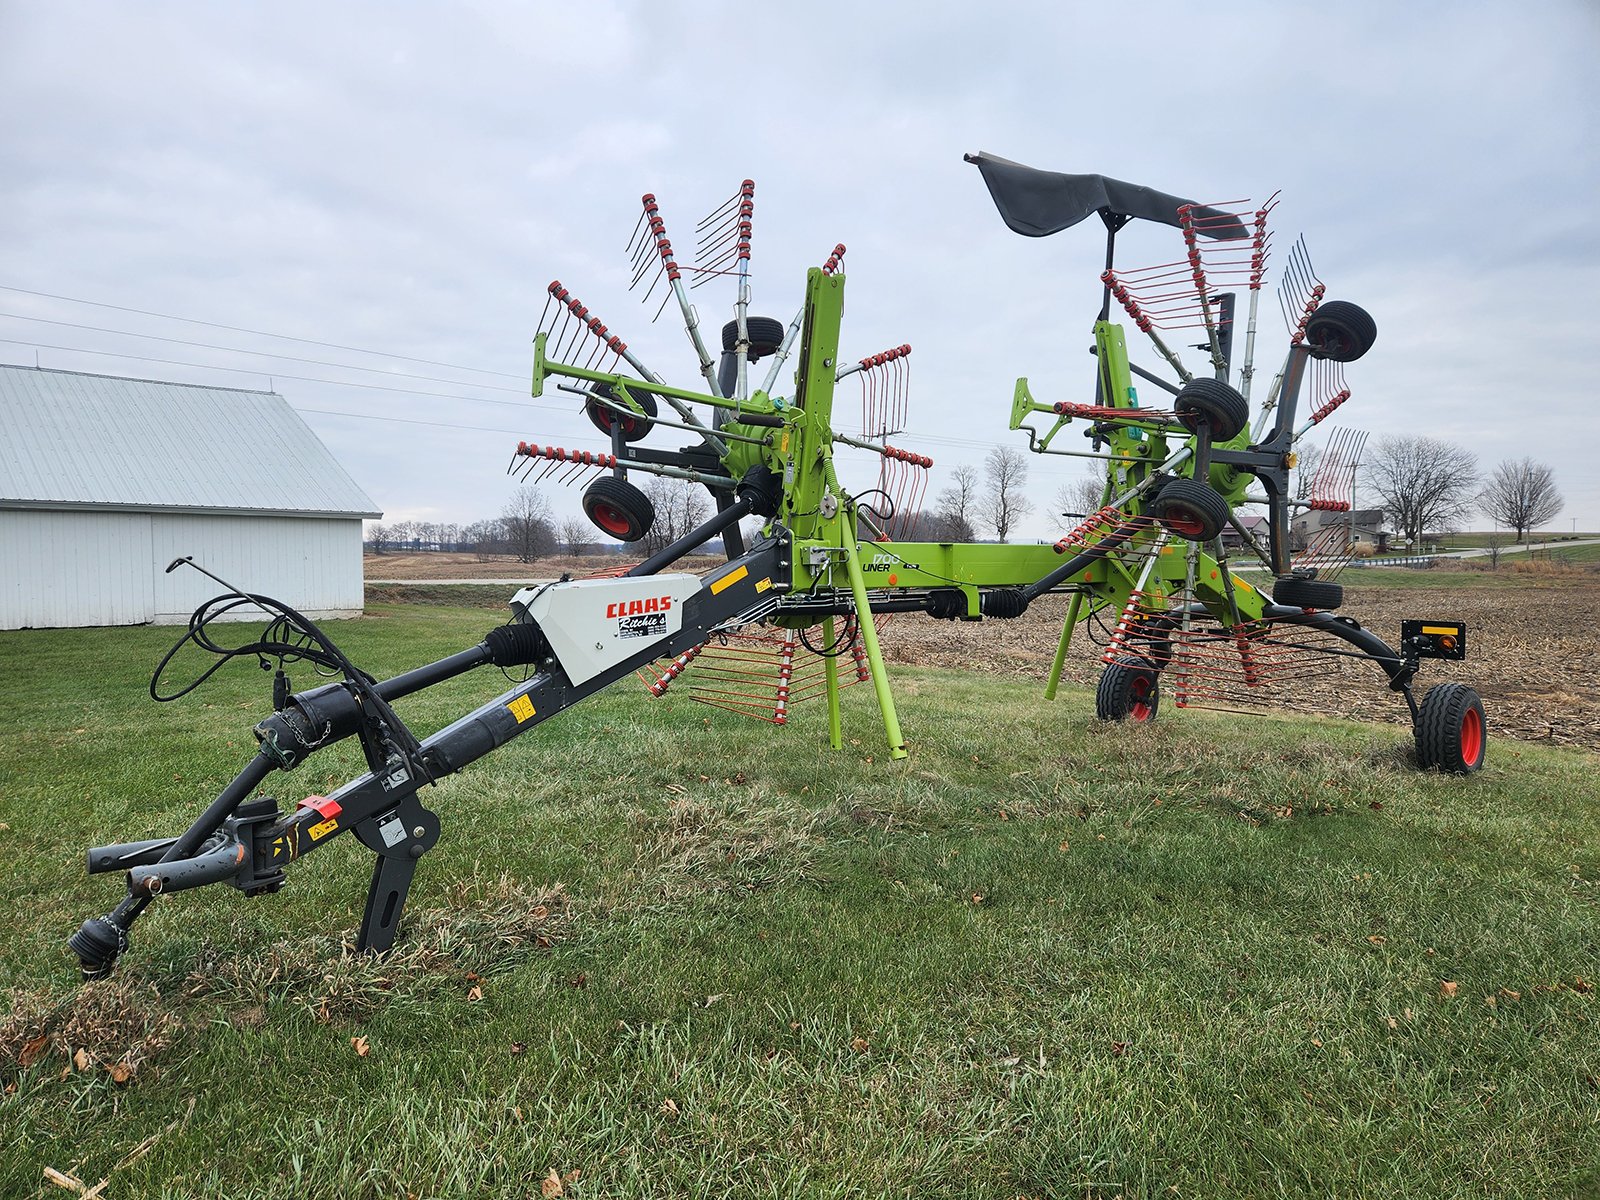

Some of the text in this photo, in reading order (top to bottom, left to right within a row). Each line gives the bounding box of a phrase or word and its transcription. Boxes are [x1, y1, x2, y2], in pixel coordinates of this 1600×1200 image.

[872, 553, 900, 564] 1700
[863, 563, 890, 572] LINER
[606, 595, 671, 618] CLAAS
[619, 613, 665, 629] Ritchie's
